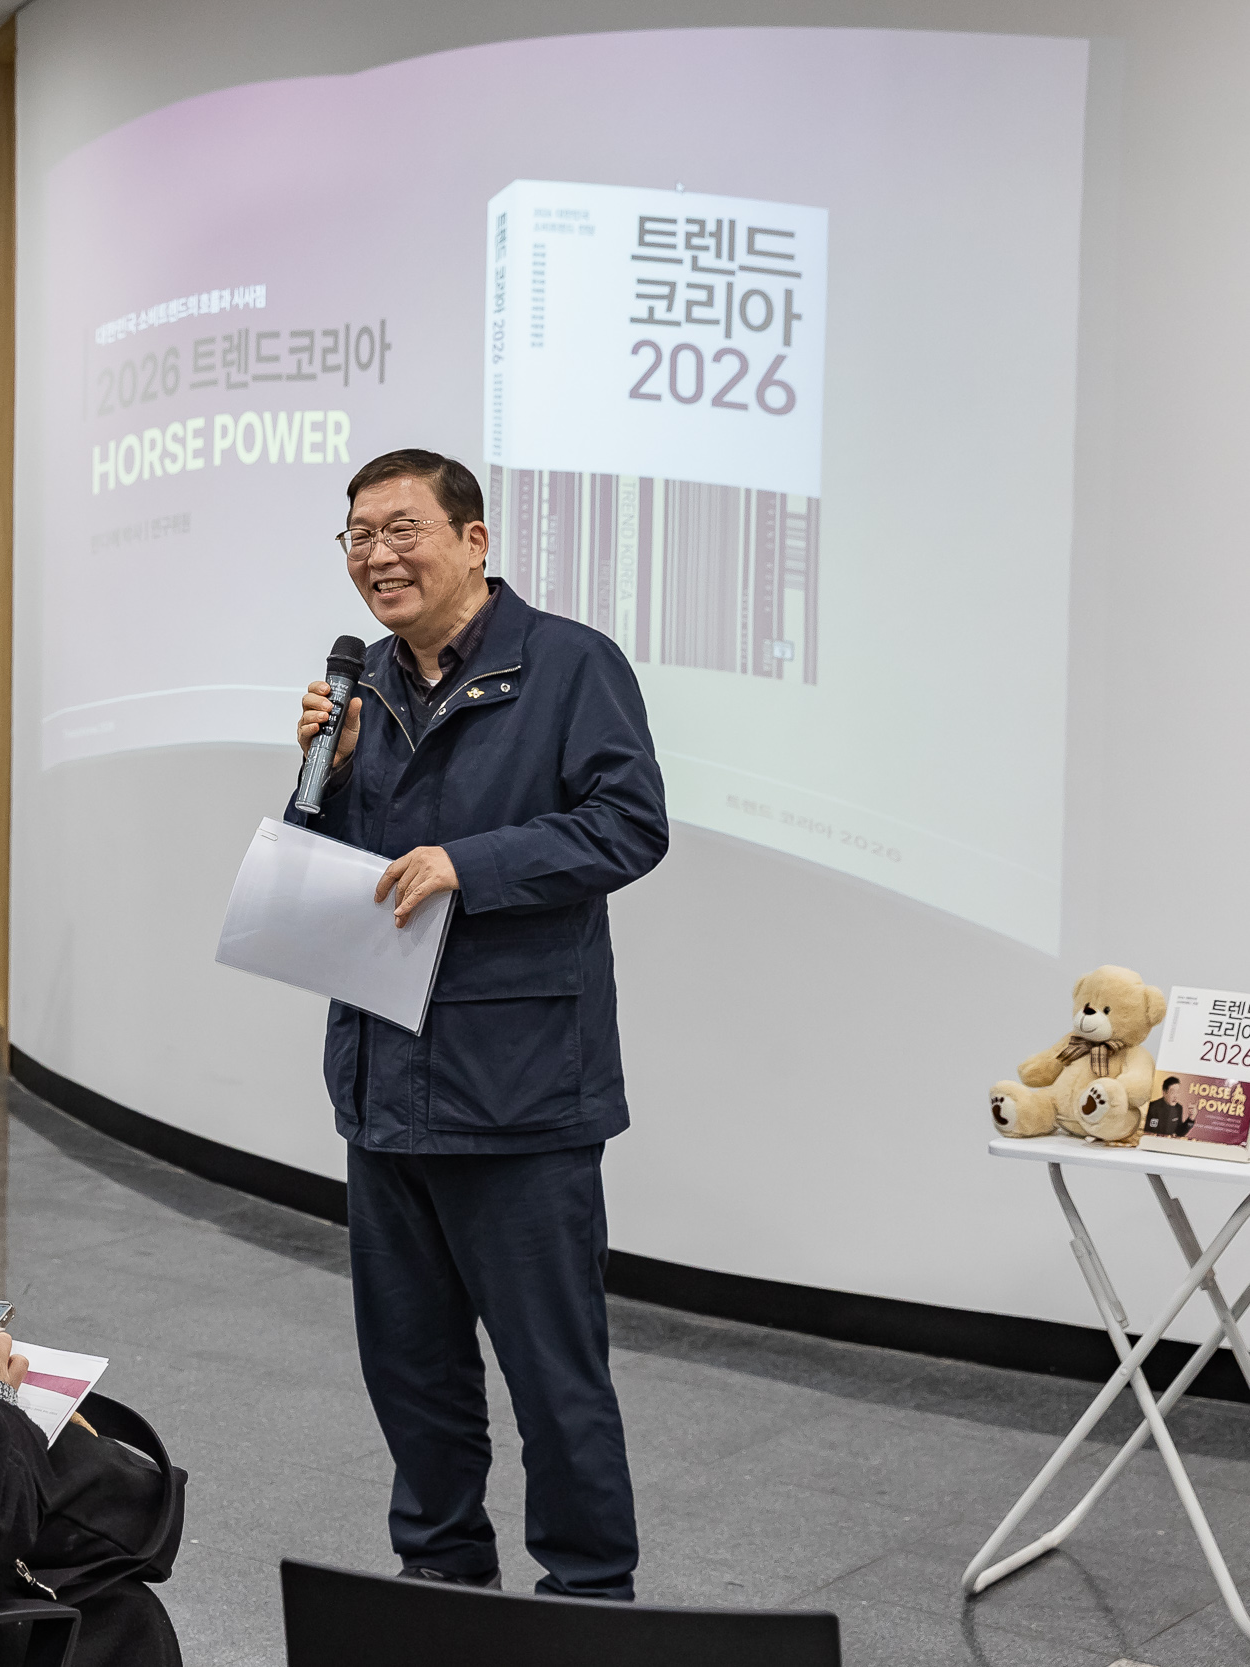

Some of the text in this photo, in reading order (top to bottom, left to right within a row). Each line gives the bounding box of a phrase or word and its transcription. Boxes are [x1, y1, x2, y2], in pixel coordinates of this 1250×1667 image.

[630, 215, 802, 279] 트렌드
[491, 318, 505, 364] 2026
[629, 278, 803, 347] 코리아
[97, 318, 392, 417] 2026 트렌드코리아
[629, 339, 797, 415] 2026
[92, 410, 350, 495] HORSE POWER
[621, 480, 637, 539] TREND
[619, 544, 636, 602] KOREA
[840, 830, 903, 863] 2026
[1189, 1082, 1230, 1100] HORSE
[1198, 1099, 1245, 1118] POWER
